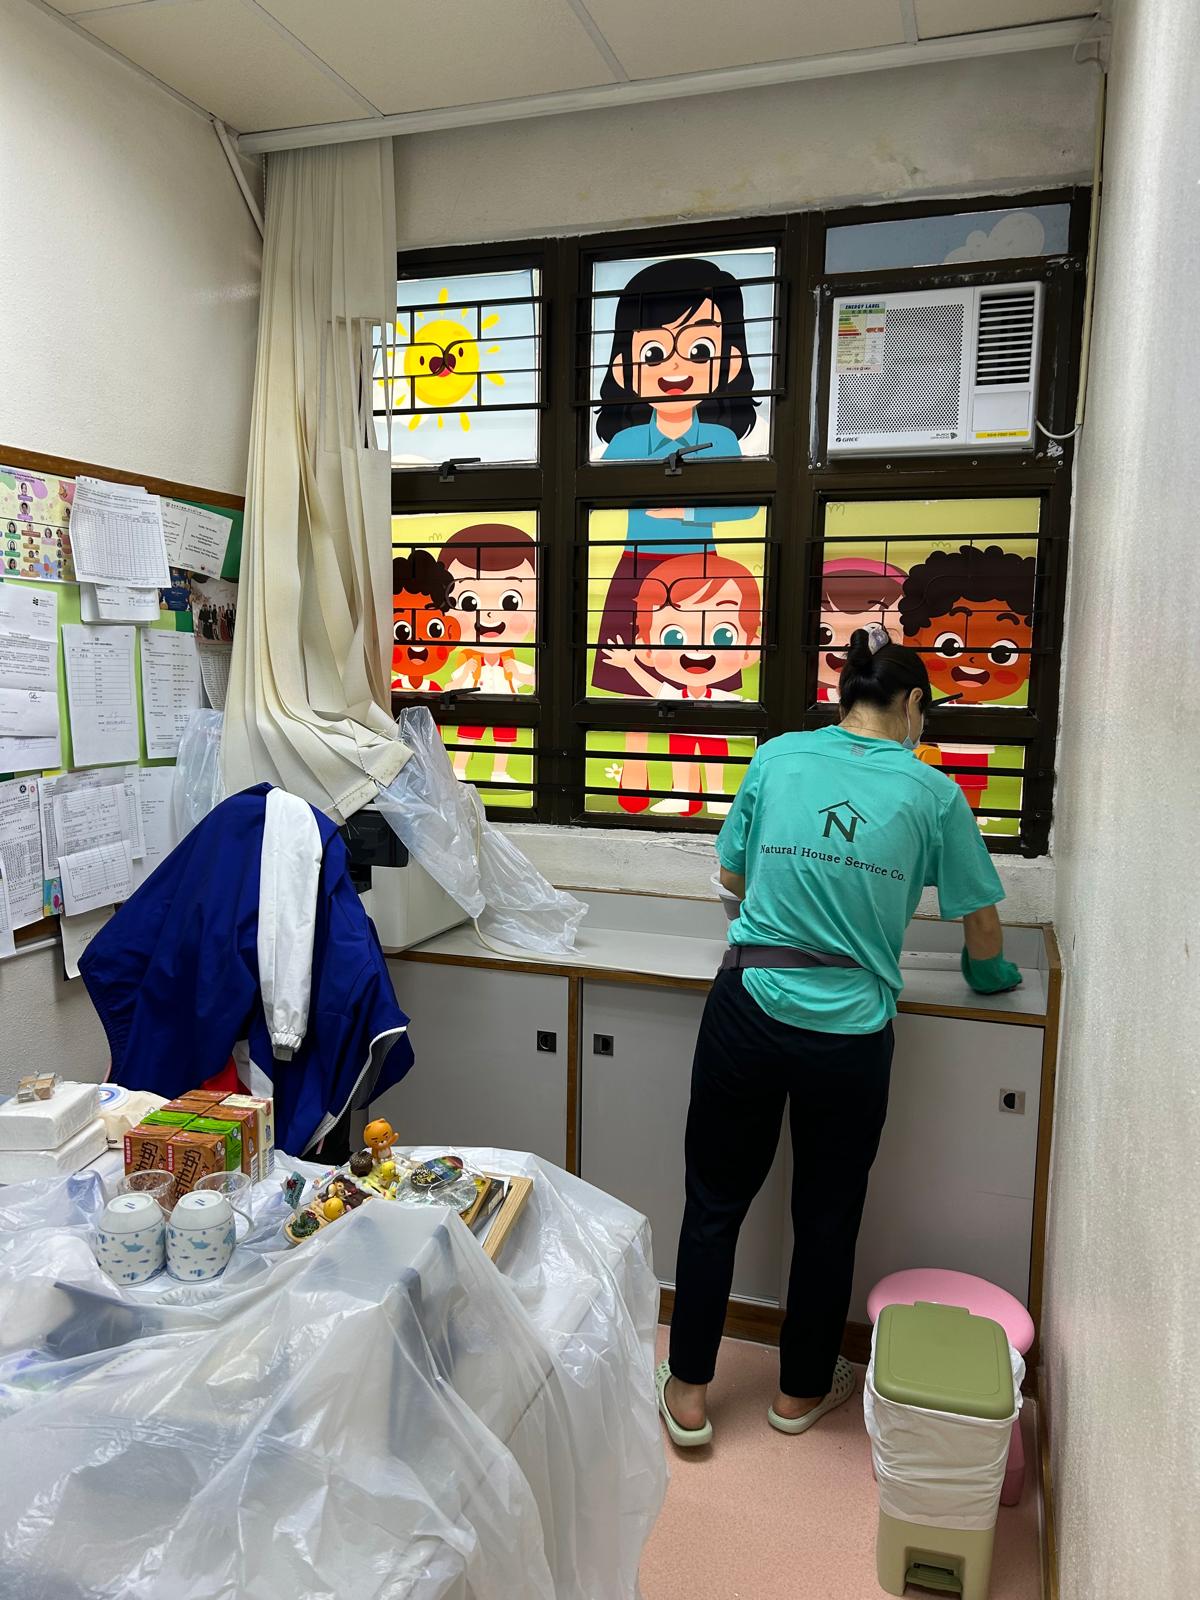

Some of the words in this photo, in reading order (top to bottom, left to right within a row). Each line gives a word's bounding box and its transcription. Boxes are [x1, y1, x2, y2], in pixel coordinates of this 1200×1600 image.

[760, 845, 796, 855] Natural
[801, 847, 840, 864] House
[844, 856, 887, 876] Service
[890, 869, 906, 882] Co.
